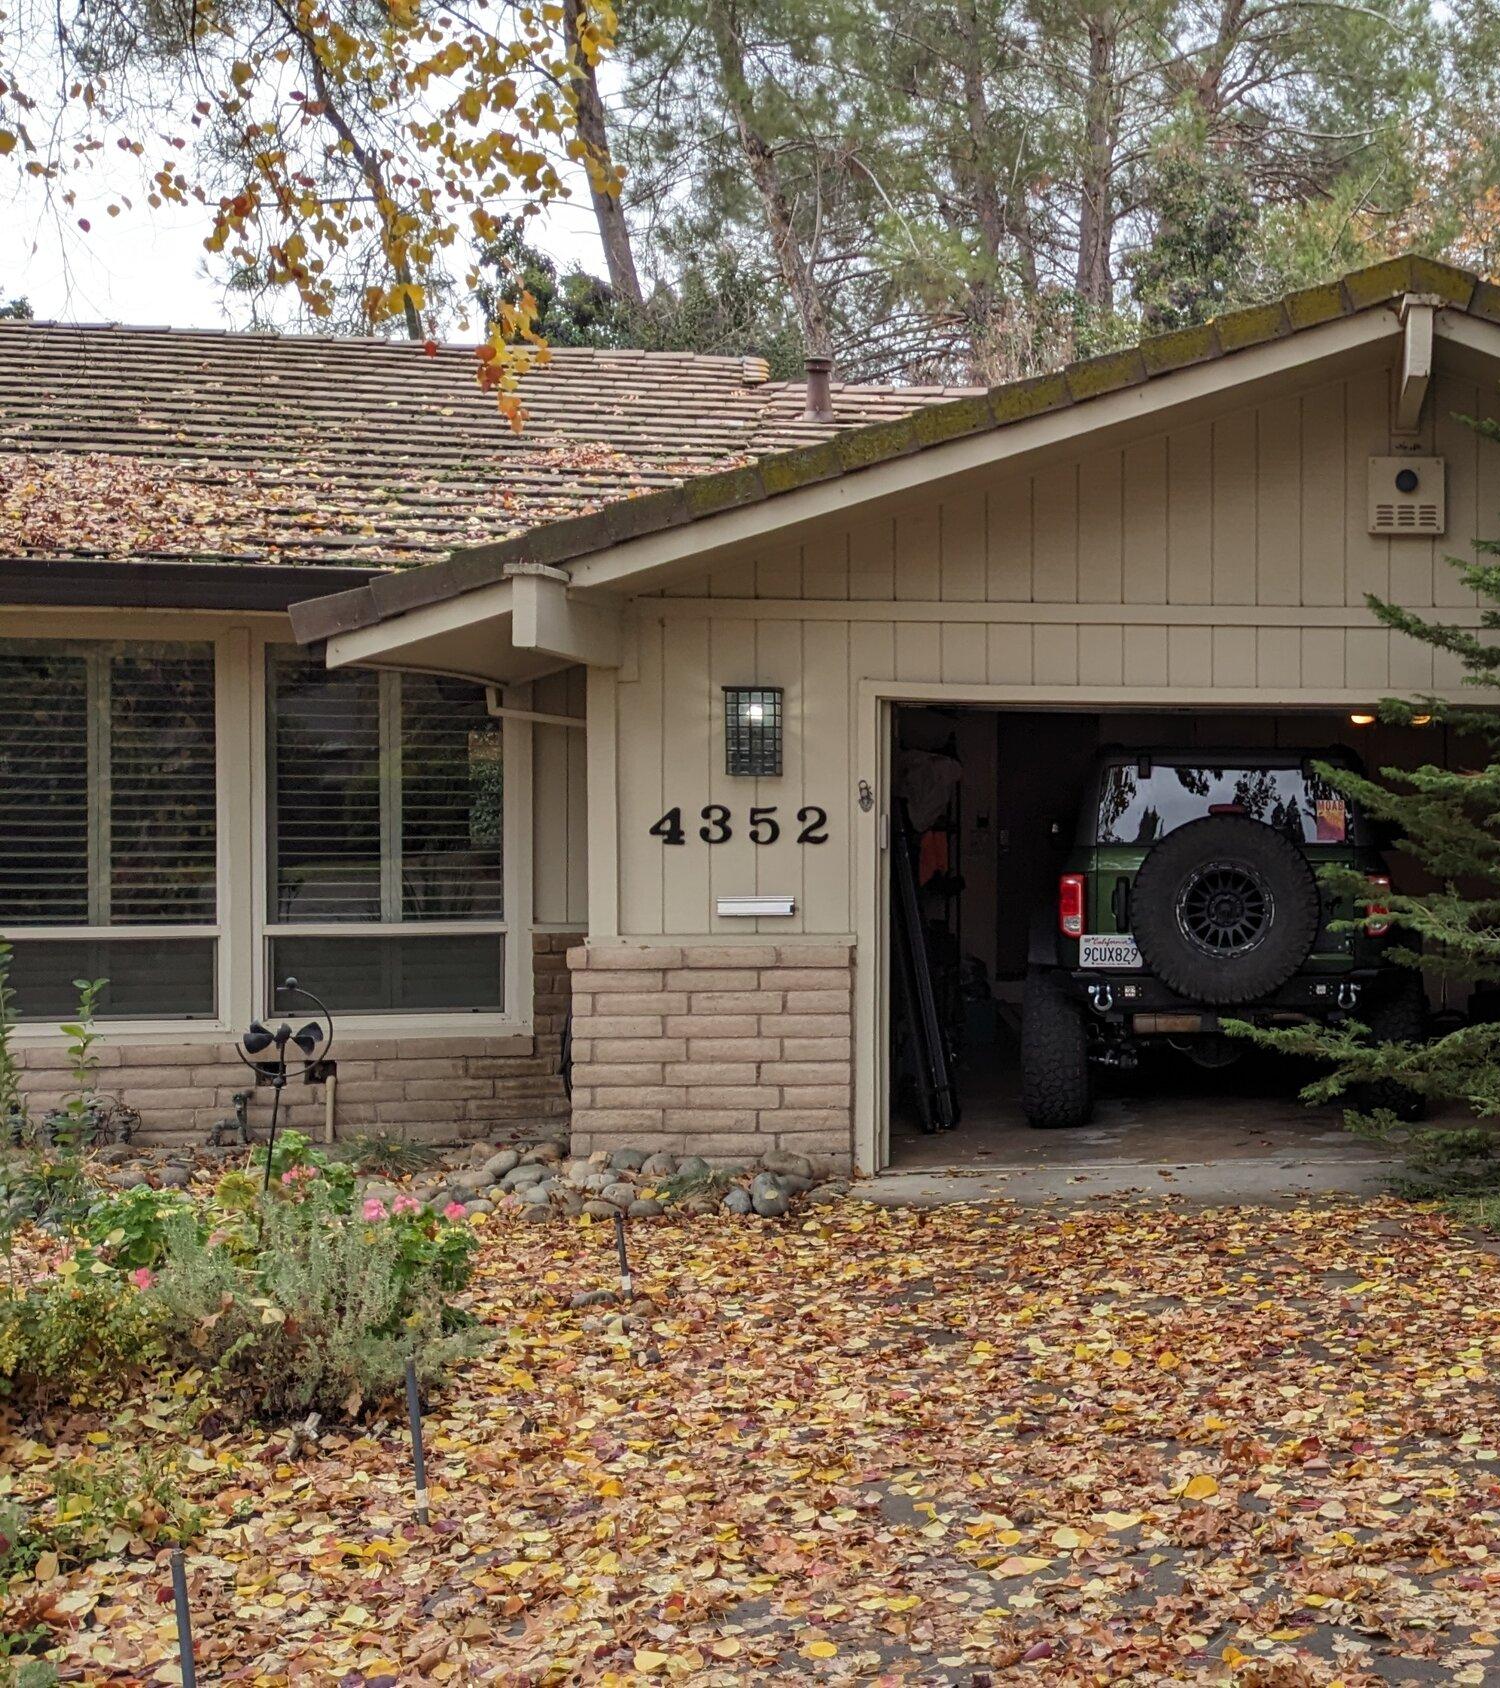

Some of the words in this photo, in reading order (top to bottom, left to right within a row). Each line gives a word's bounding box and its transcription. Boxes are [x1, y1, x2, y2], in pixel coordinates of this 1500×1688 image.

[1317, 800, 1345, 811] MOAB
[649, 804, 829, 846] 4352
[1083, 947, 1139, 962] 9CUX829
